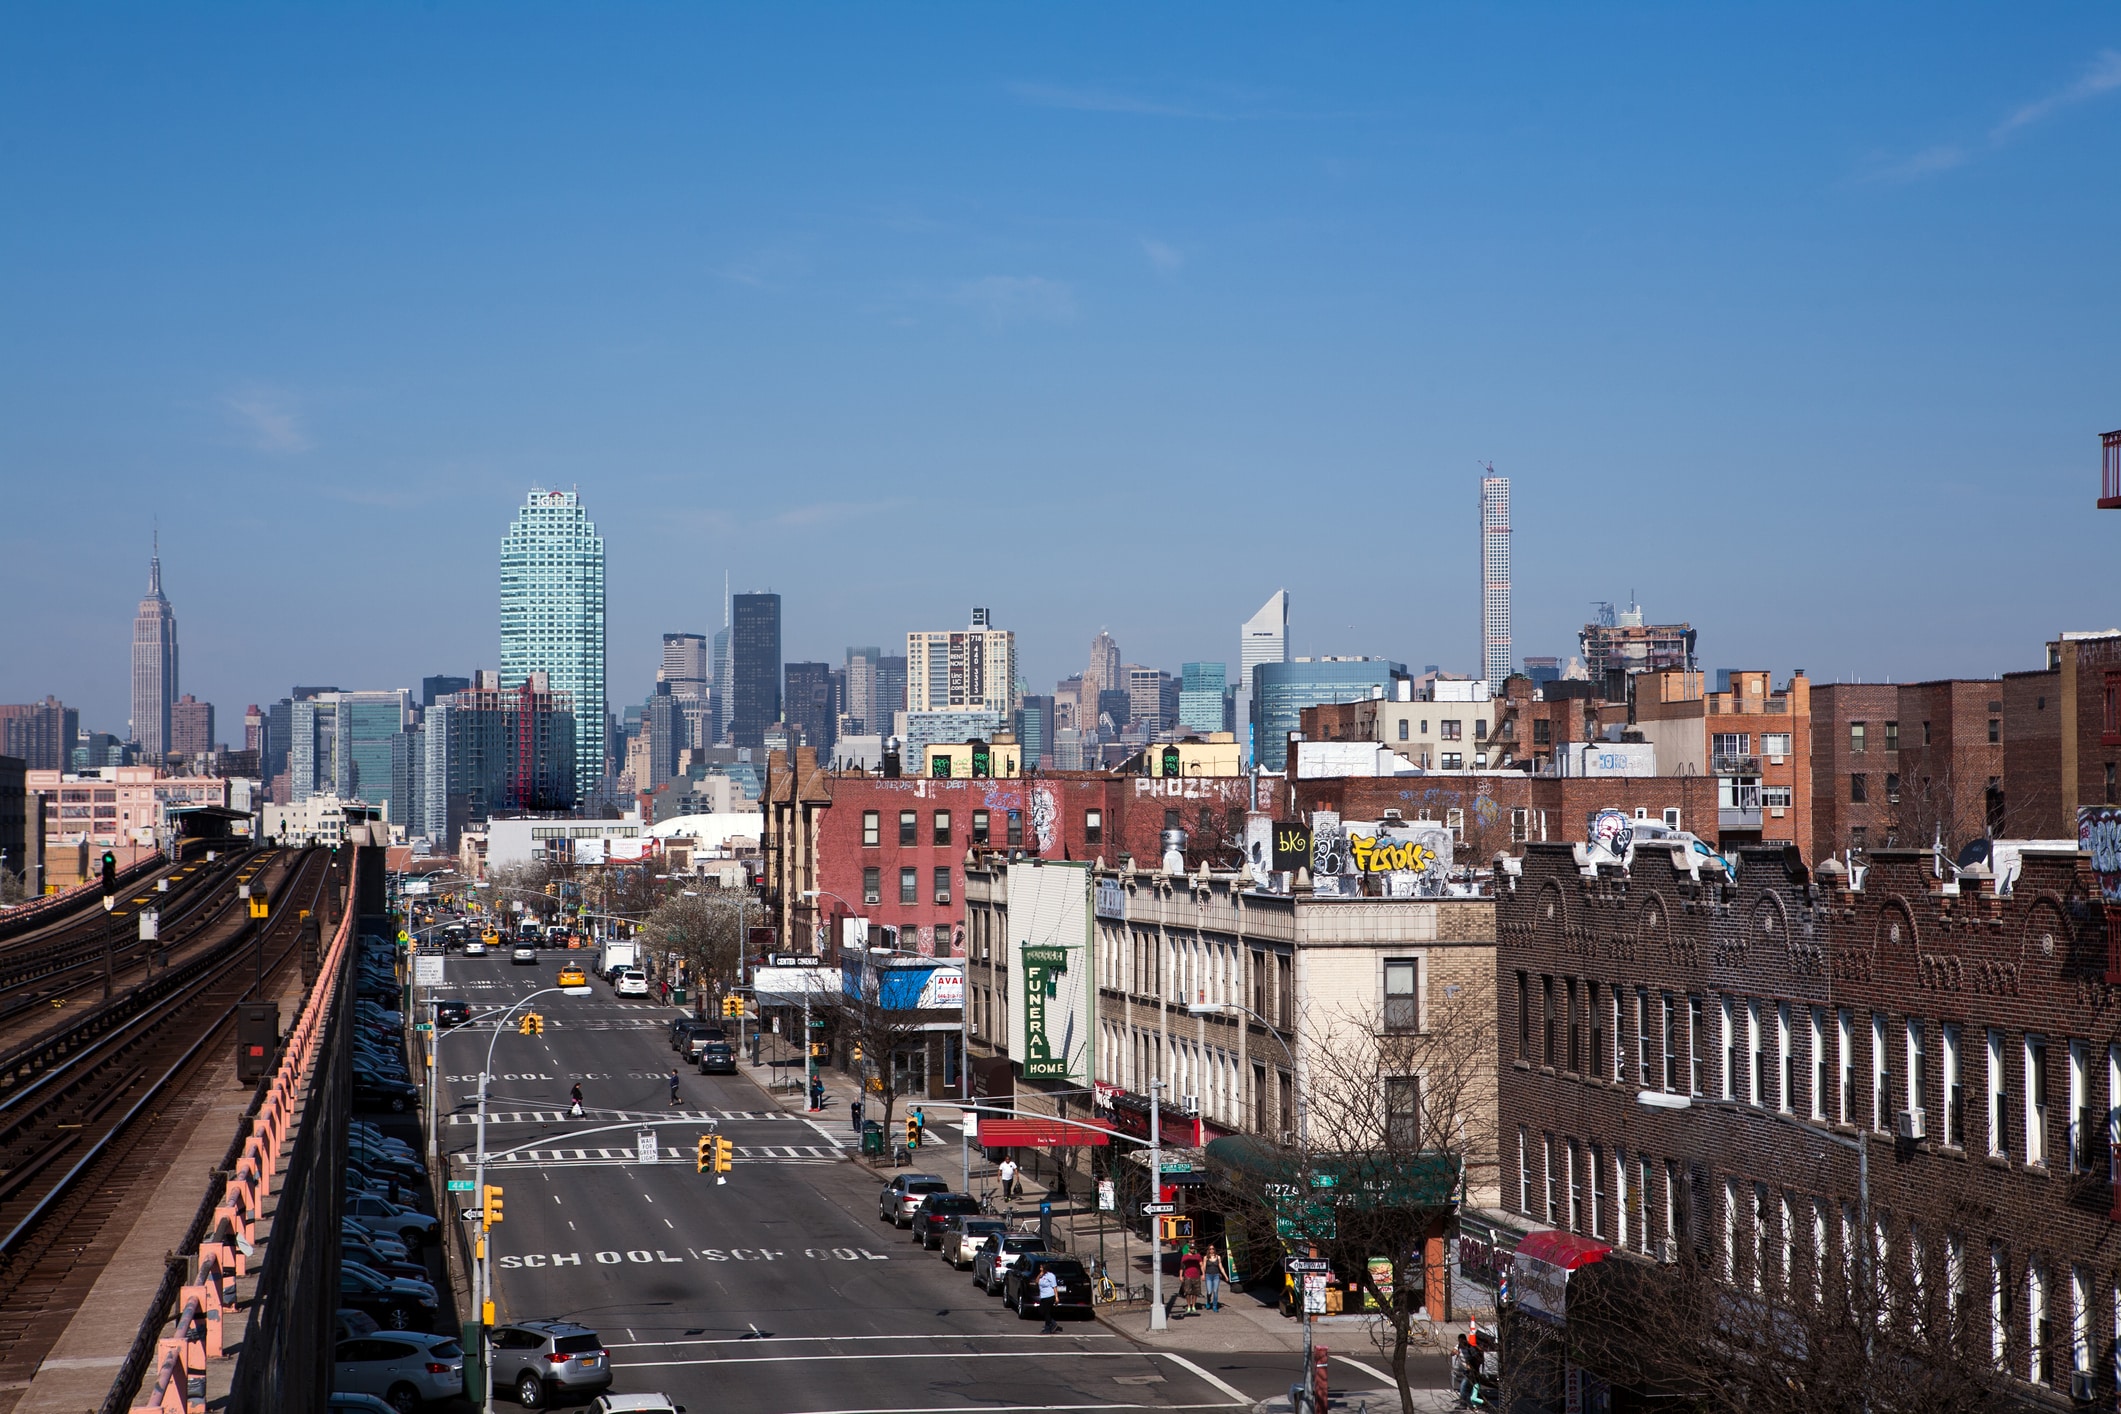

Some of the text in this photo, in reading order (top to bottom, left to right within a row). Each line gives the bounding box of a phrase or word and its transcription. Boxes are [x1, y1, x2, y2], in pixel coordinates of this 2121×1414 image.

[970, 634, 982, 642] 718
[776, 957, 819, 966] CENTER CINEMAS
[1028, 967, 1043, 1059] FUNERAL
[1030, 1064, 1064, 1074] HOME
[452, 1182, 465, 1190] 44
[500, 1250, 683, 1269] SCHOOL
[1294, 1261, 1326, 1269] ONE WAY
